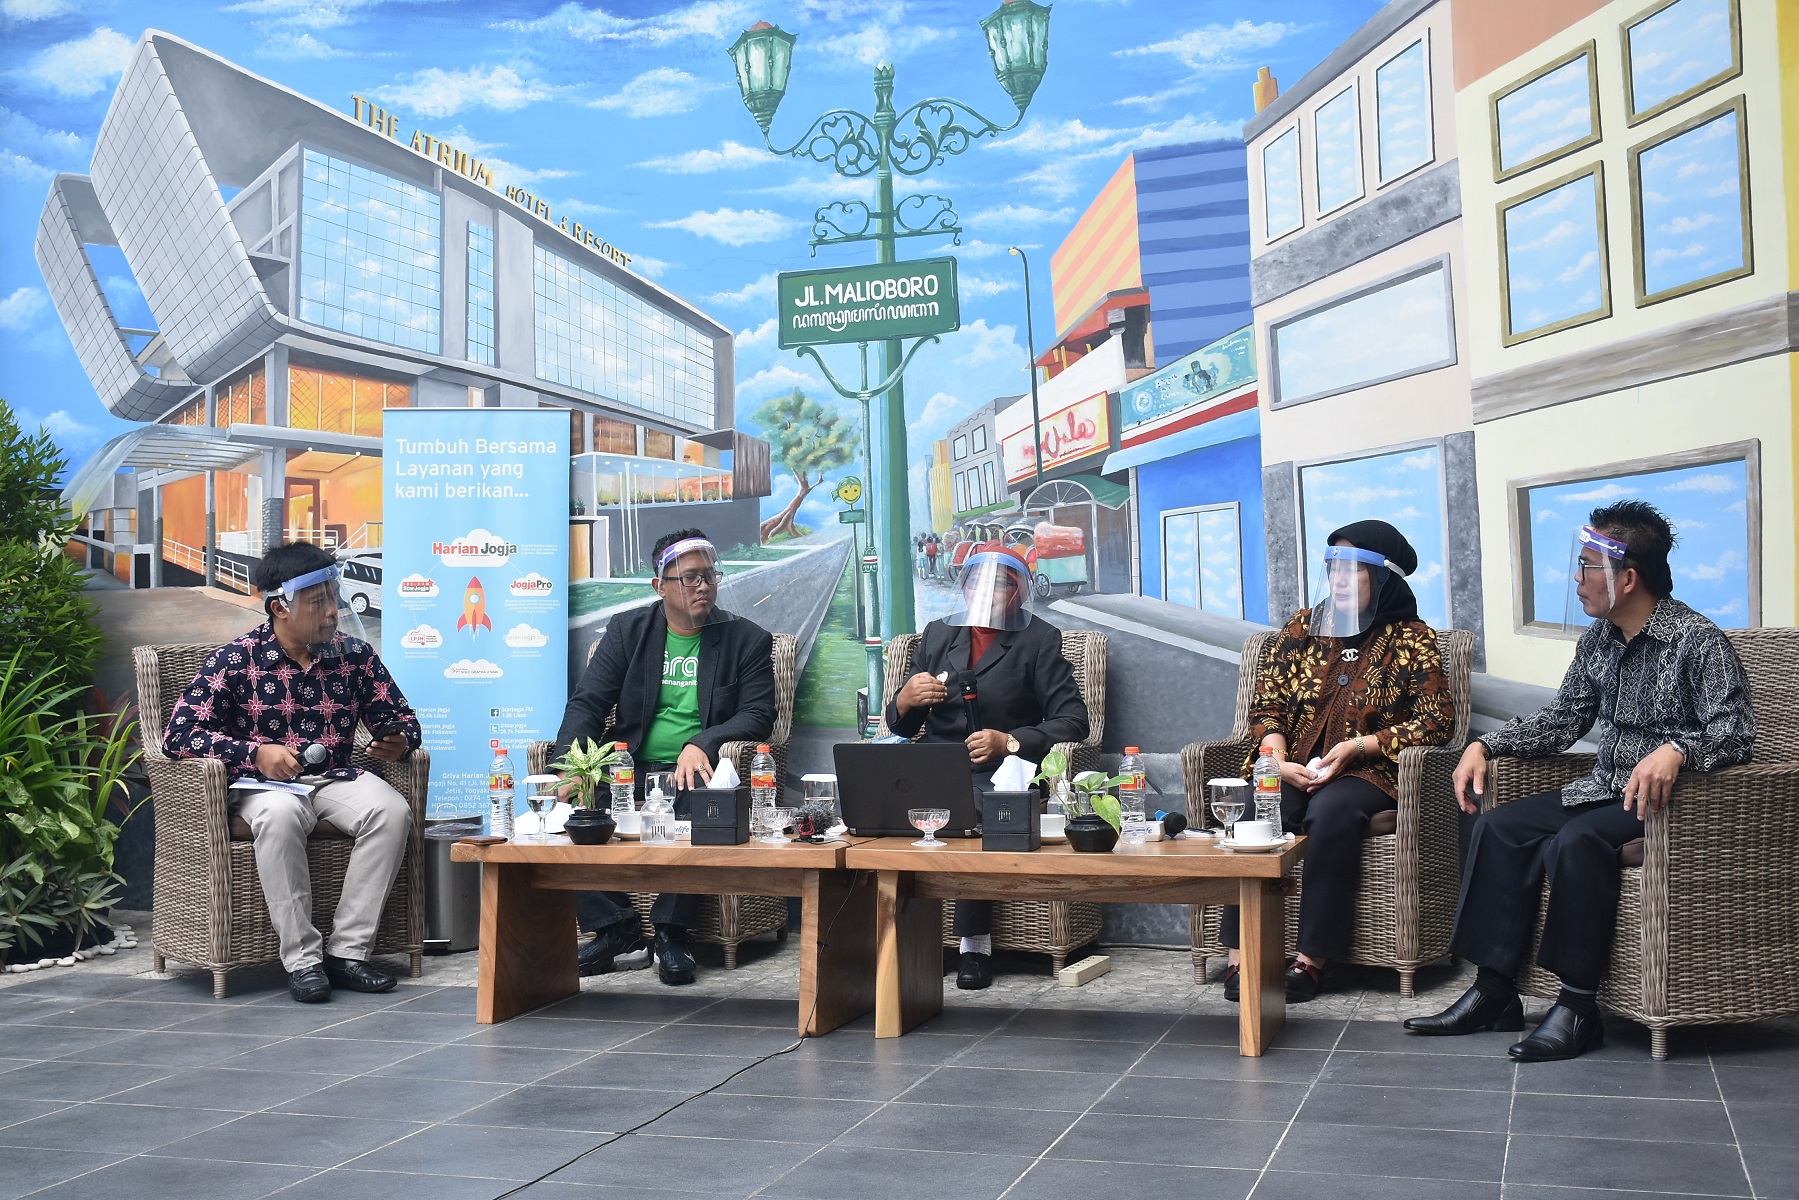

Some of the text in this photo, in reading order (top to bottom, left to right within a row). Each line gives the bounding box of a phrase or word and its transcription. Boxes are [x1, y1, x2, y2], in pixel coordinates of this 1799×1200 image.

[351, 94, 632, 267] THE ATRIUM HOTEL & RESORT
[825, 274, 939, 304] MALIOBORO
[395, 438, 557, 454] Tumbuh Bersama
[395, 461, 524, 479] Layanan yang
[395, 483, 529, 498] kami berikan...
[432, 542, 479, 554] Harian
[480, 542, 517, 556] Jogja
[511, 580, 552, 590] JogjaPro
